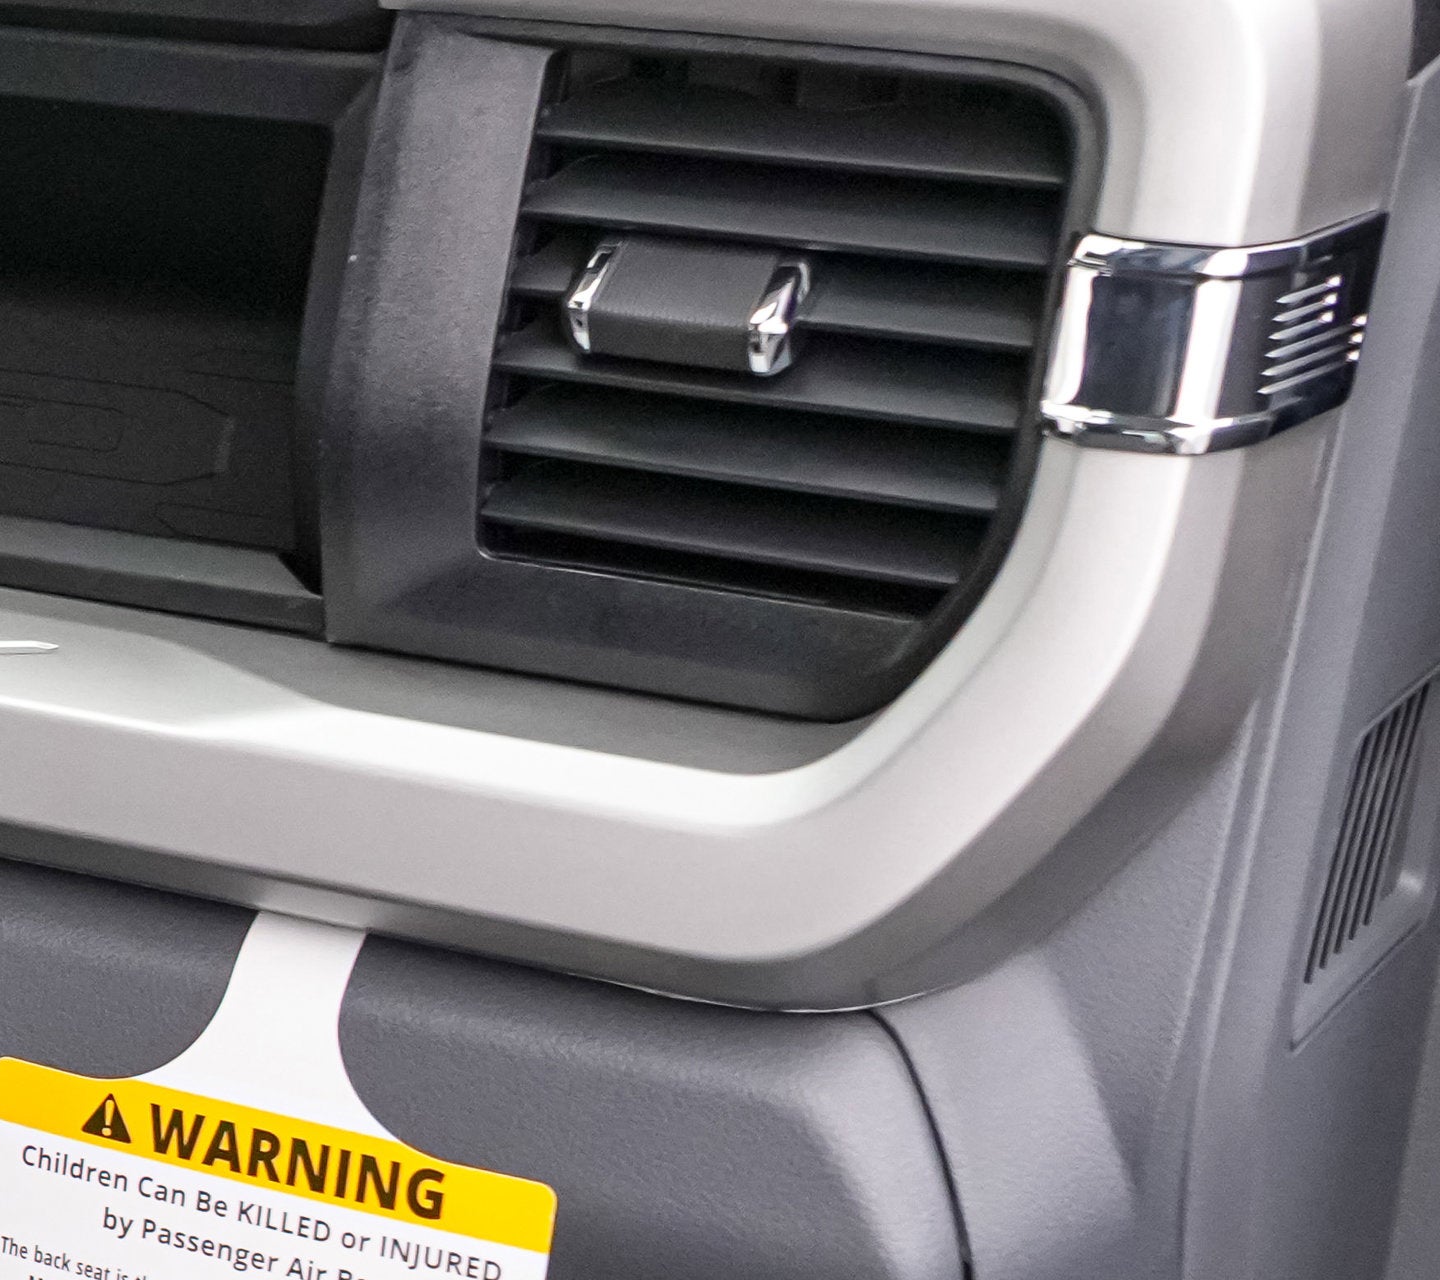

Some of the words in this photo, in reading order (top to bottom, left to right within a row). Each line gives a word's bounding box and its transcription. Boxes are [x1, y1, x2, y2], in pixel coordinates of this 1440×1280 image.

[21, 1145, 128, 1192] Children
[138, 1176, 186, 1207] Can
[196, 1190, 228, 1217] Be
[237, 1201, 331, 1242] KILLED
[341, 1231, 371, 1252] or
[150, 1103, 446, 1220] WARNING
[0, 1236, 28, 1260] The
[33, 1244, 71, 1272] back
[102, 1206, 134, 1239] by
[142, 1218, 279, 1272] Passenger
